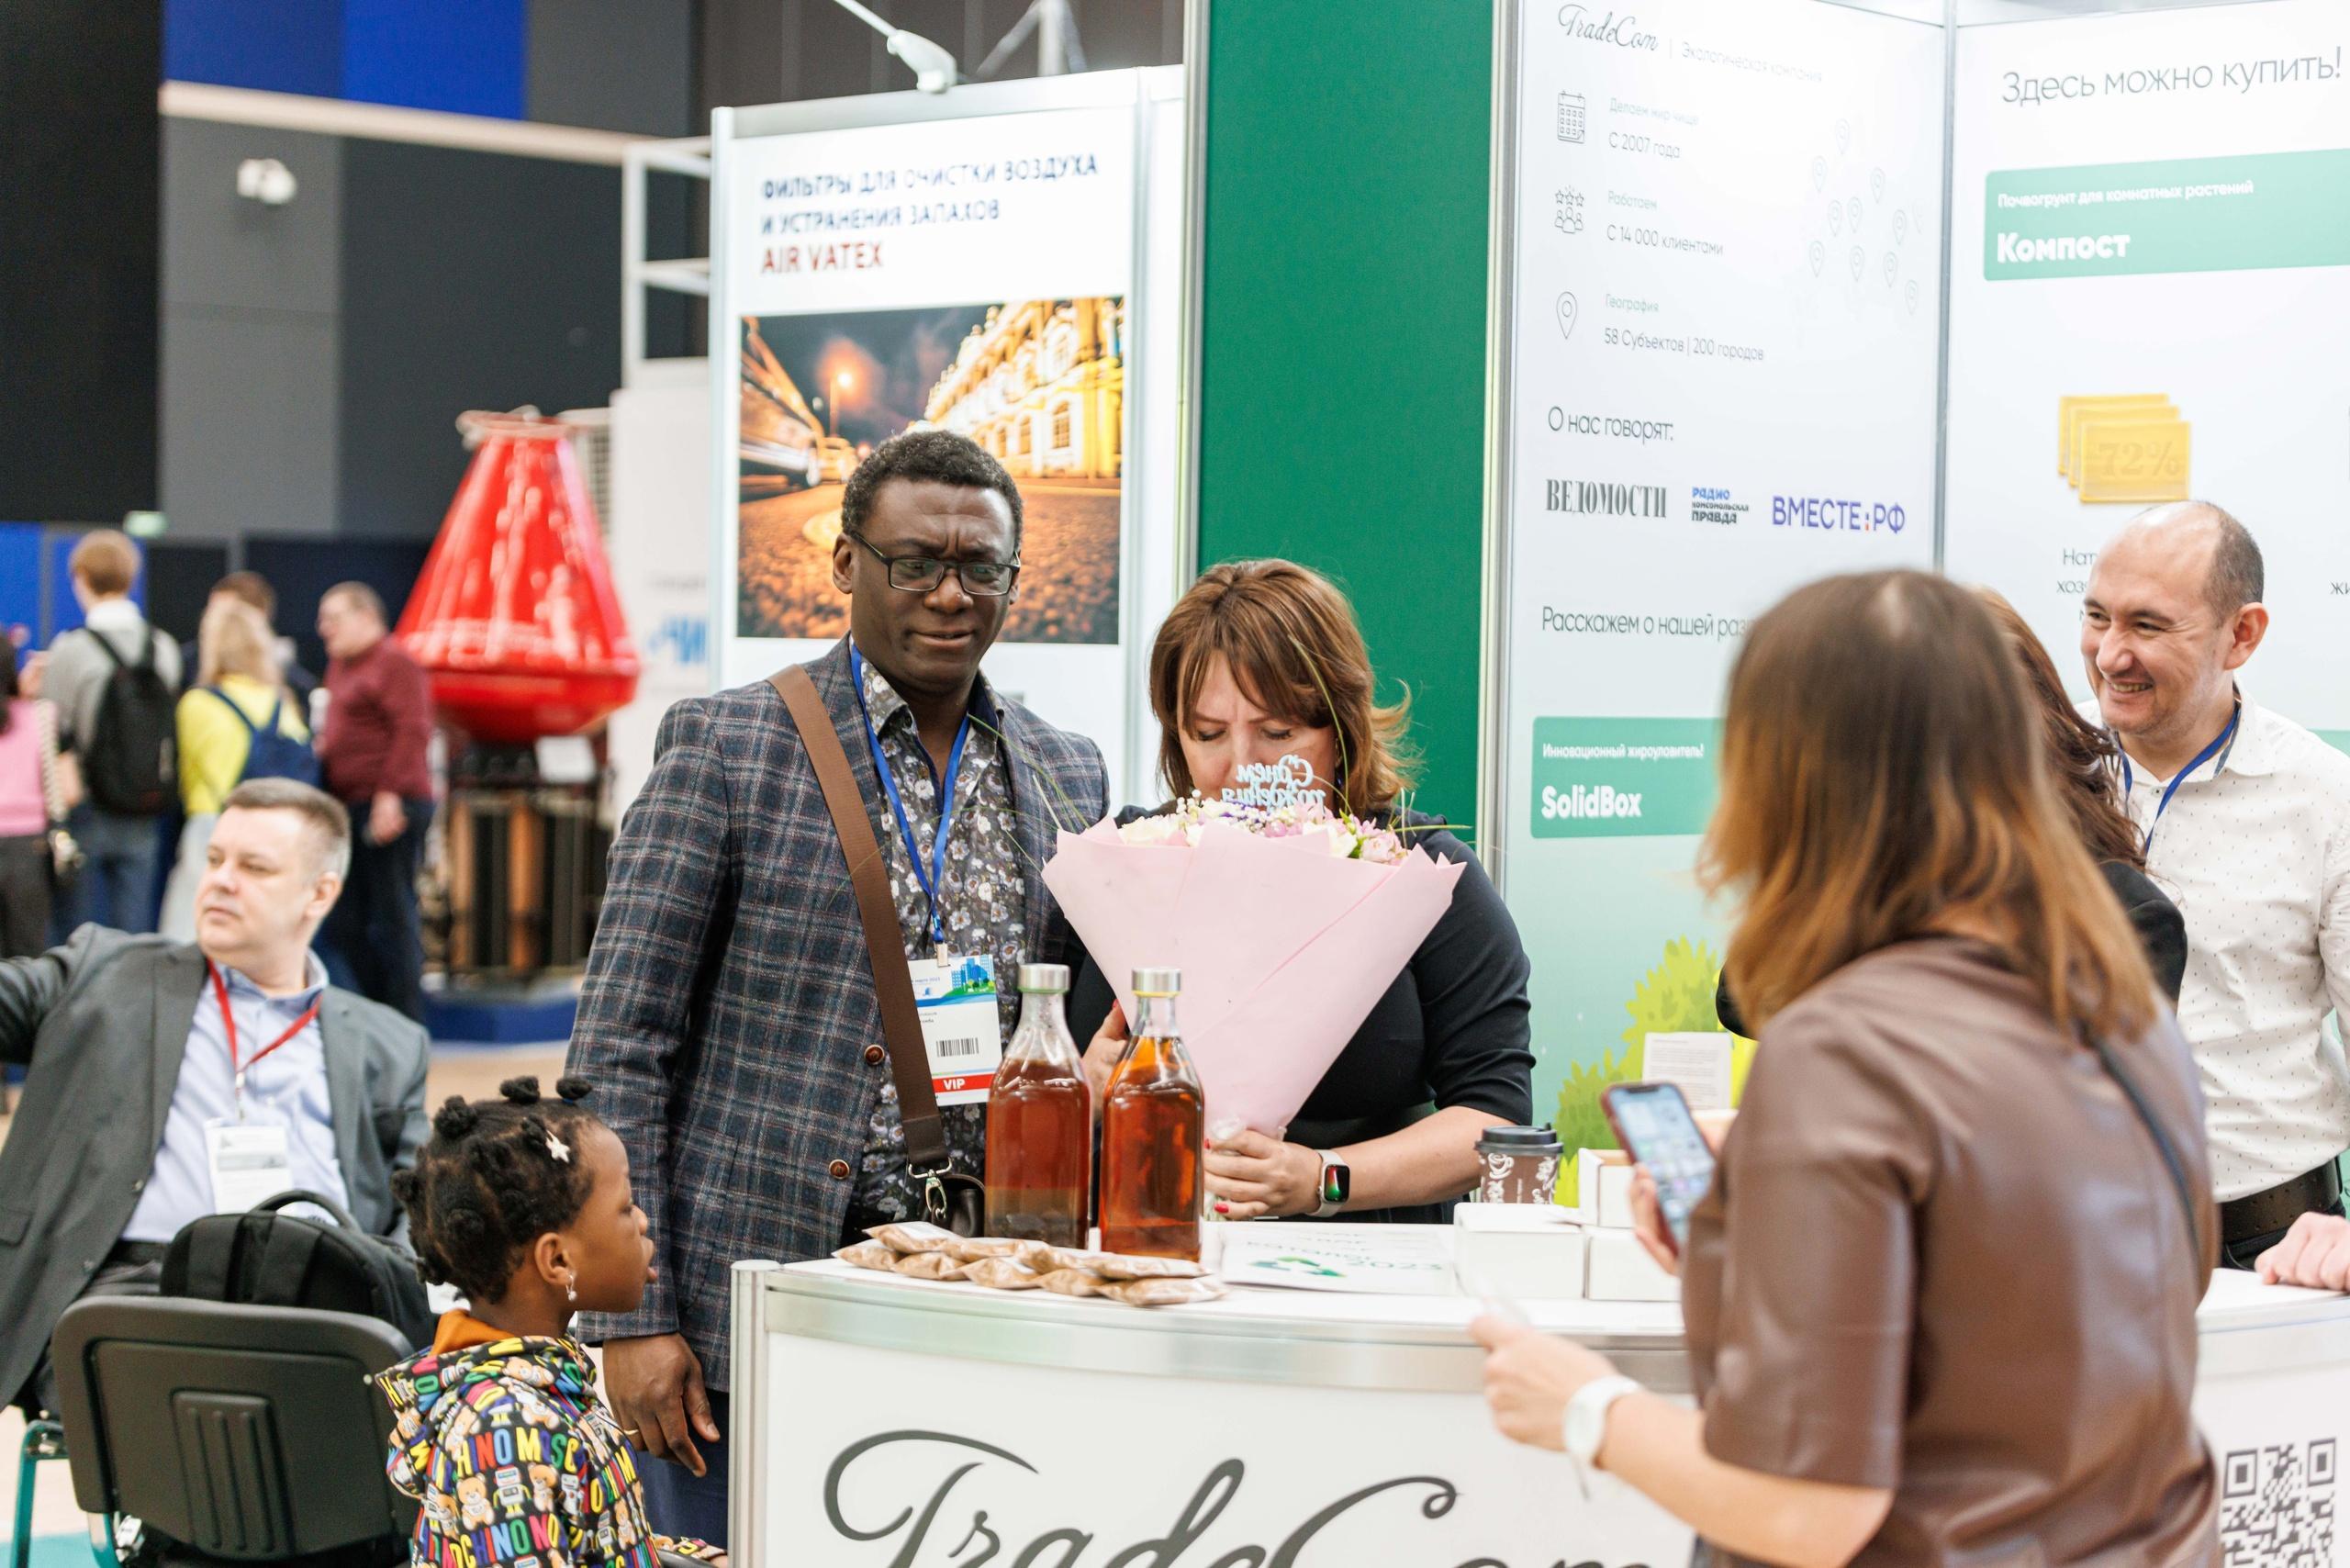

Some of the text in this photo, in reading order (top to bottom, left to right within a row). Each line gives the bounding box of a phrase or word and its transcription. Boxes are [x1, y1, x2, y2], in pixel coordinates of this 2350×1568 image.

[1558, 4, 1659, 51] TradeCom
[1682, 41, 1822, 84] Экологическая компания
[2002, 46, 2342, 107] Здесь можно купить!
[1609, 98, 1650, 119] Делаем
[1622, 133, 1651, 155] 2007
[1653, 142, 1681, 160] года
[764, 152, 1099, 201] ФИЛЬТРЫ ДЛЯ ОЧИСТКИ ВОЗДУХА
[1608, 191, 1658, 211] Работаем
[1998, 180, 2255, 208] Почвогрунт для комнатных растений
[762, 198, 1001, 236] И УСТРАНЕНИЯ ЗАПАХОВ
[761, 241, 883, 274] AIR VATEX
[1619, 226, 1632, 242] 14
[1634, 229, 1660, 248] 000
[1662, 233, 1724, 257] клиентами
[1997, 232, 2131, 263] Компост
[1606, 294, 1660, 315] География
[1605, 328, 1764, 362] 58 Субъектов 200 городов
[1568, 412, 1601, 436] нас
[1605, 416, 1674, 445] говорят:
[2098, 441, 2181, 478] 72%
[1545, 478, 1668, 520] ВЕДОМОСТИ
[2063, 548, 2098, 566] Нат
[1542, 606, 1639, 634] Расскажем
[1643, 617, 1656, 636] о
[1658, 613, 1714, 637] нашей
[1541, 784, 1643, 820] SolidBox
[943, 1078, 966, 1091] VIP
